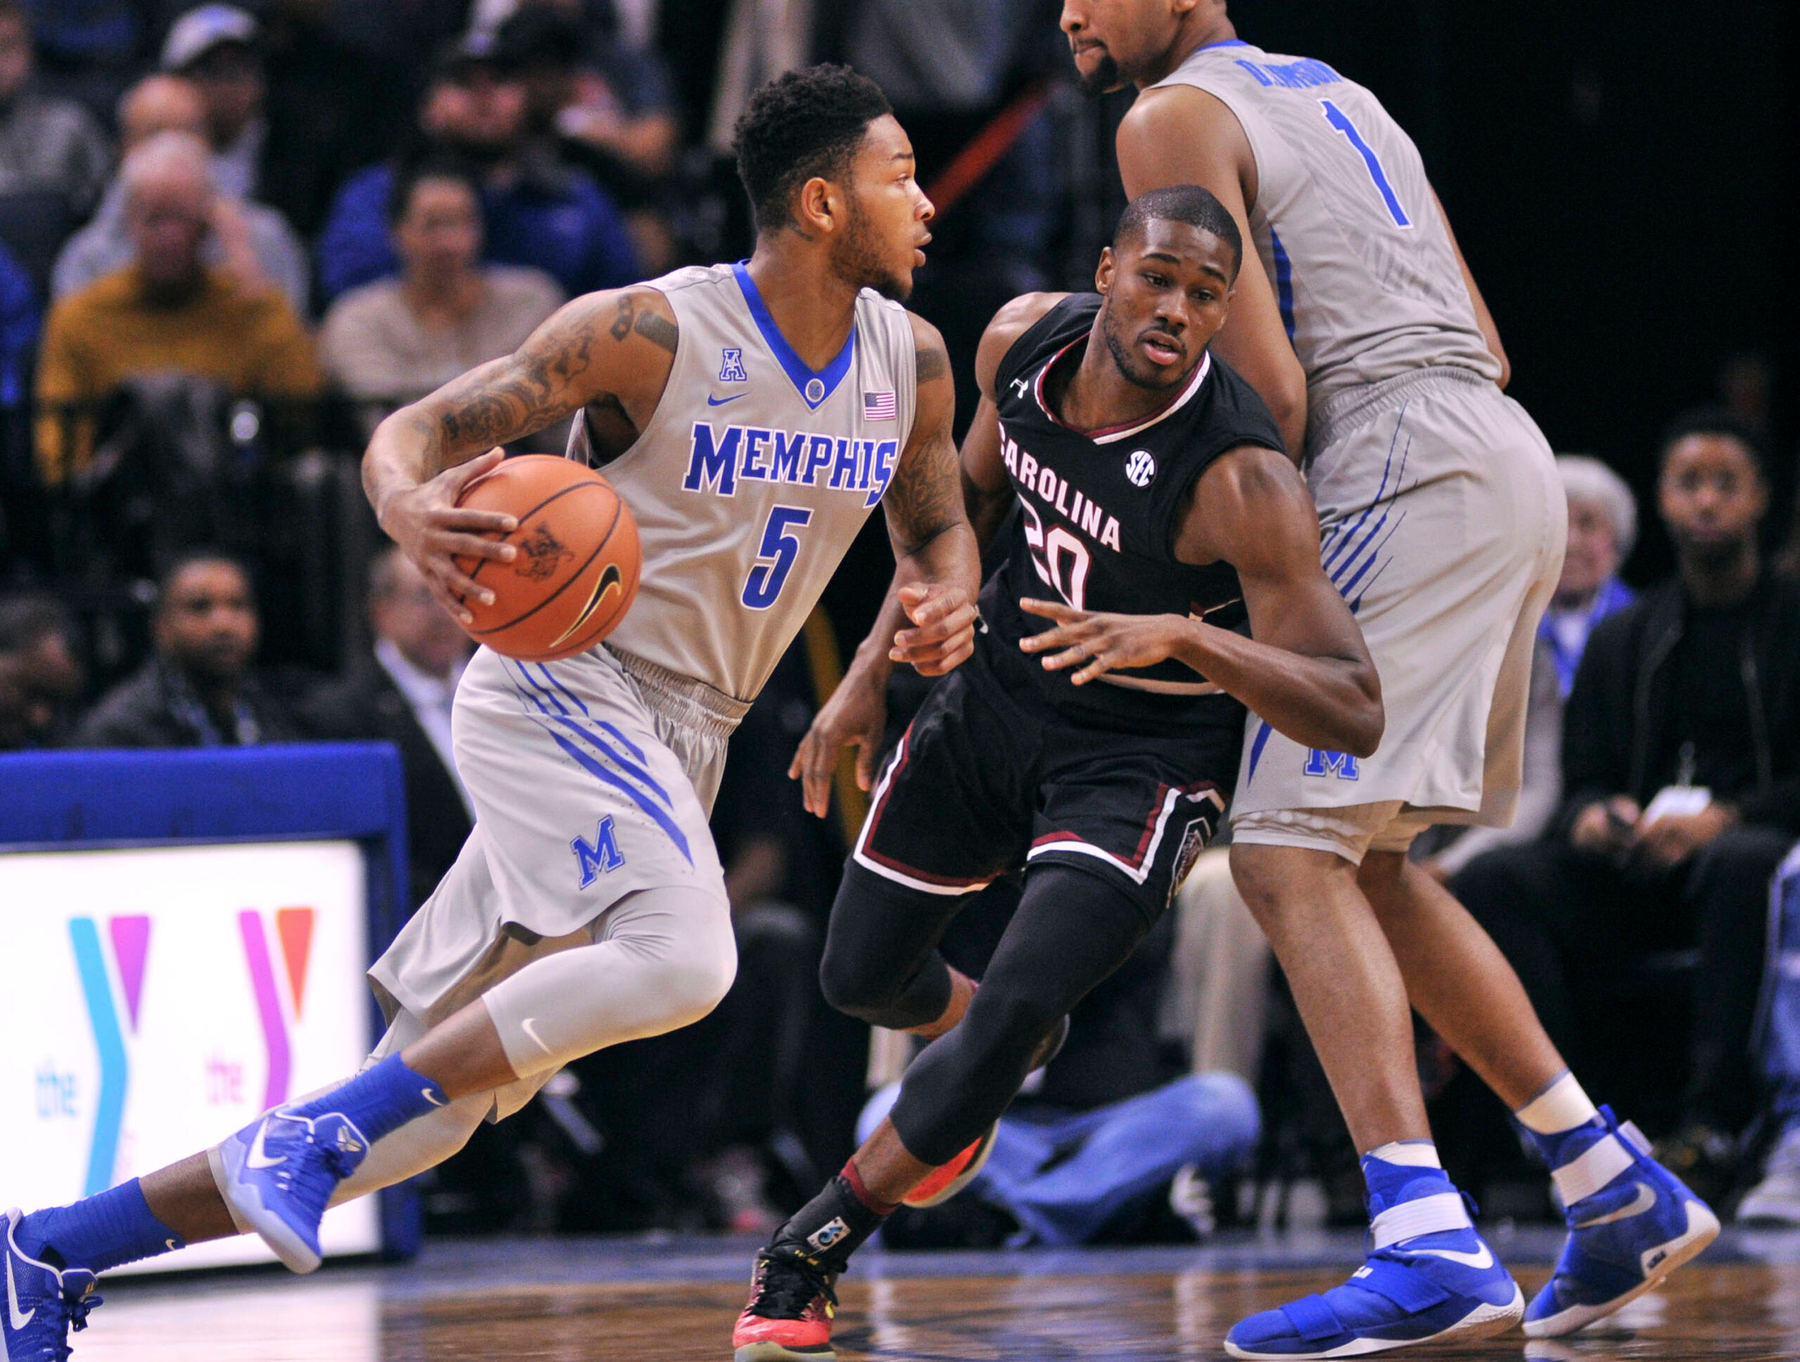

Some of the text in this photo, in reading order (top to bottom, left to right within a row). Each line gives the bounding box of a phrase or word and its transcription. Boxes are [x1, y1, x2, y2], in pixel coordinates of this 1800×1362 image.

[1317, 98, 1413, 229] 1
[1125, 449, 1156, 487] SEC
[740, 503, 815, 611] 5
[1017, 491, 1091, 613] 20
[1303, 747, 1359, 781] M
[570, 813, 626, 891] M
